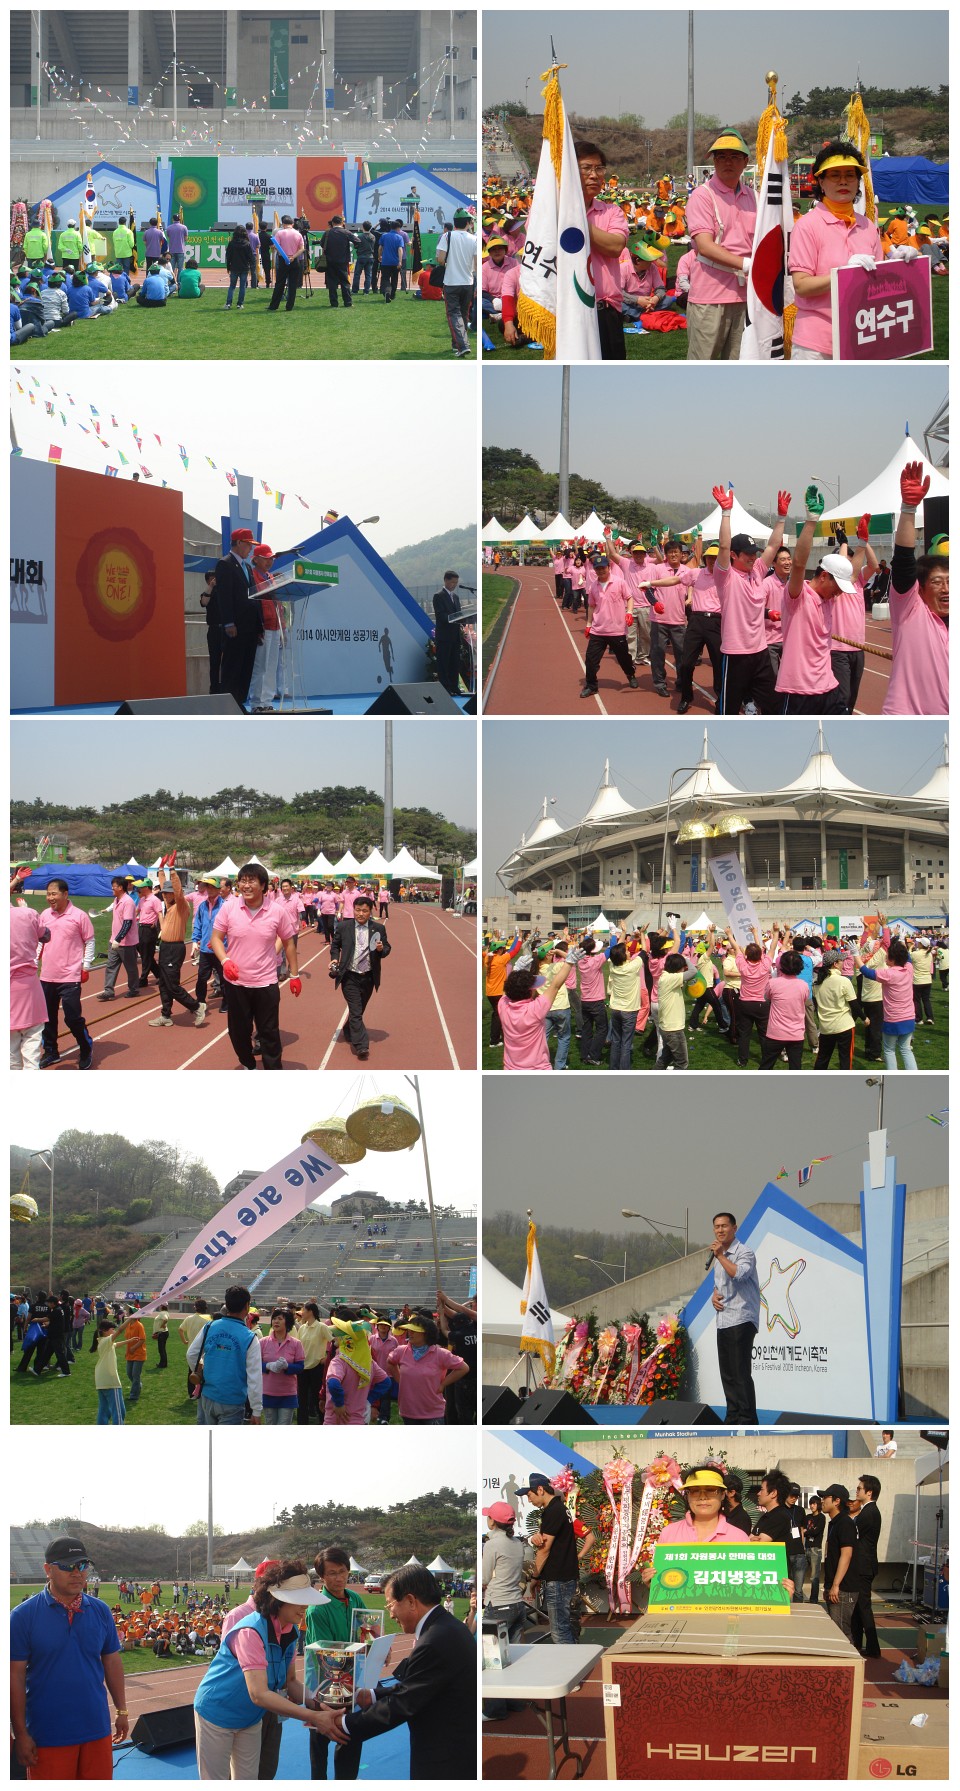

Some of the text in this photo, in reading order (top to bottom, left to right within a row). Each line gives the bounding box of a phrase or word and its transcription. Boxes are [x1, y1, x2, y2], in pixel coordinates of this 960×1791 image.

[247, 178, 267, 187] 제1회
[223, 187, 252, 196] 자원봉사
[277, 187, 292, 196] 대회
[855, 299, 915, 346] 연수구
[9, 557, 43, 586] 대회
[106, 584, 131, 602] ONE!
[315, 629, 351, 642] 아시안게임
[352, 629, 379, 642] 성공기원
[715, 860, 737, 882] We
[730, 886, 747, 912] are
[194, 1154, 333, 1269] We are the
[764, 1363, 782, 1371] Festival
[813, 1365, 828, 1373] Korea
[482, 1477, 501, 1489] 기원
[664, 1552, 776, 1561] 제1회 자원봉사 한마음 대회
[693, 1570, 779, 1585] 김치냉장고
[896, 1764, 917, 1777] LG
